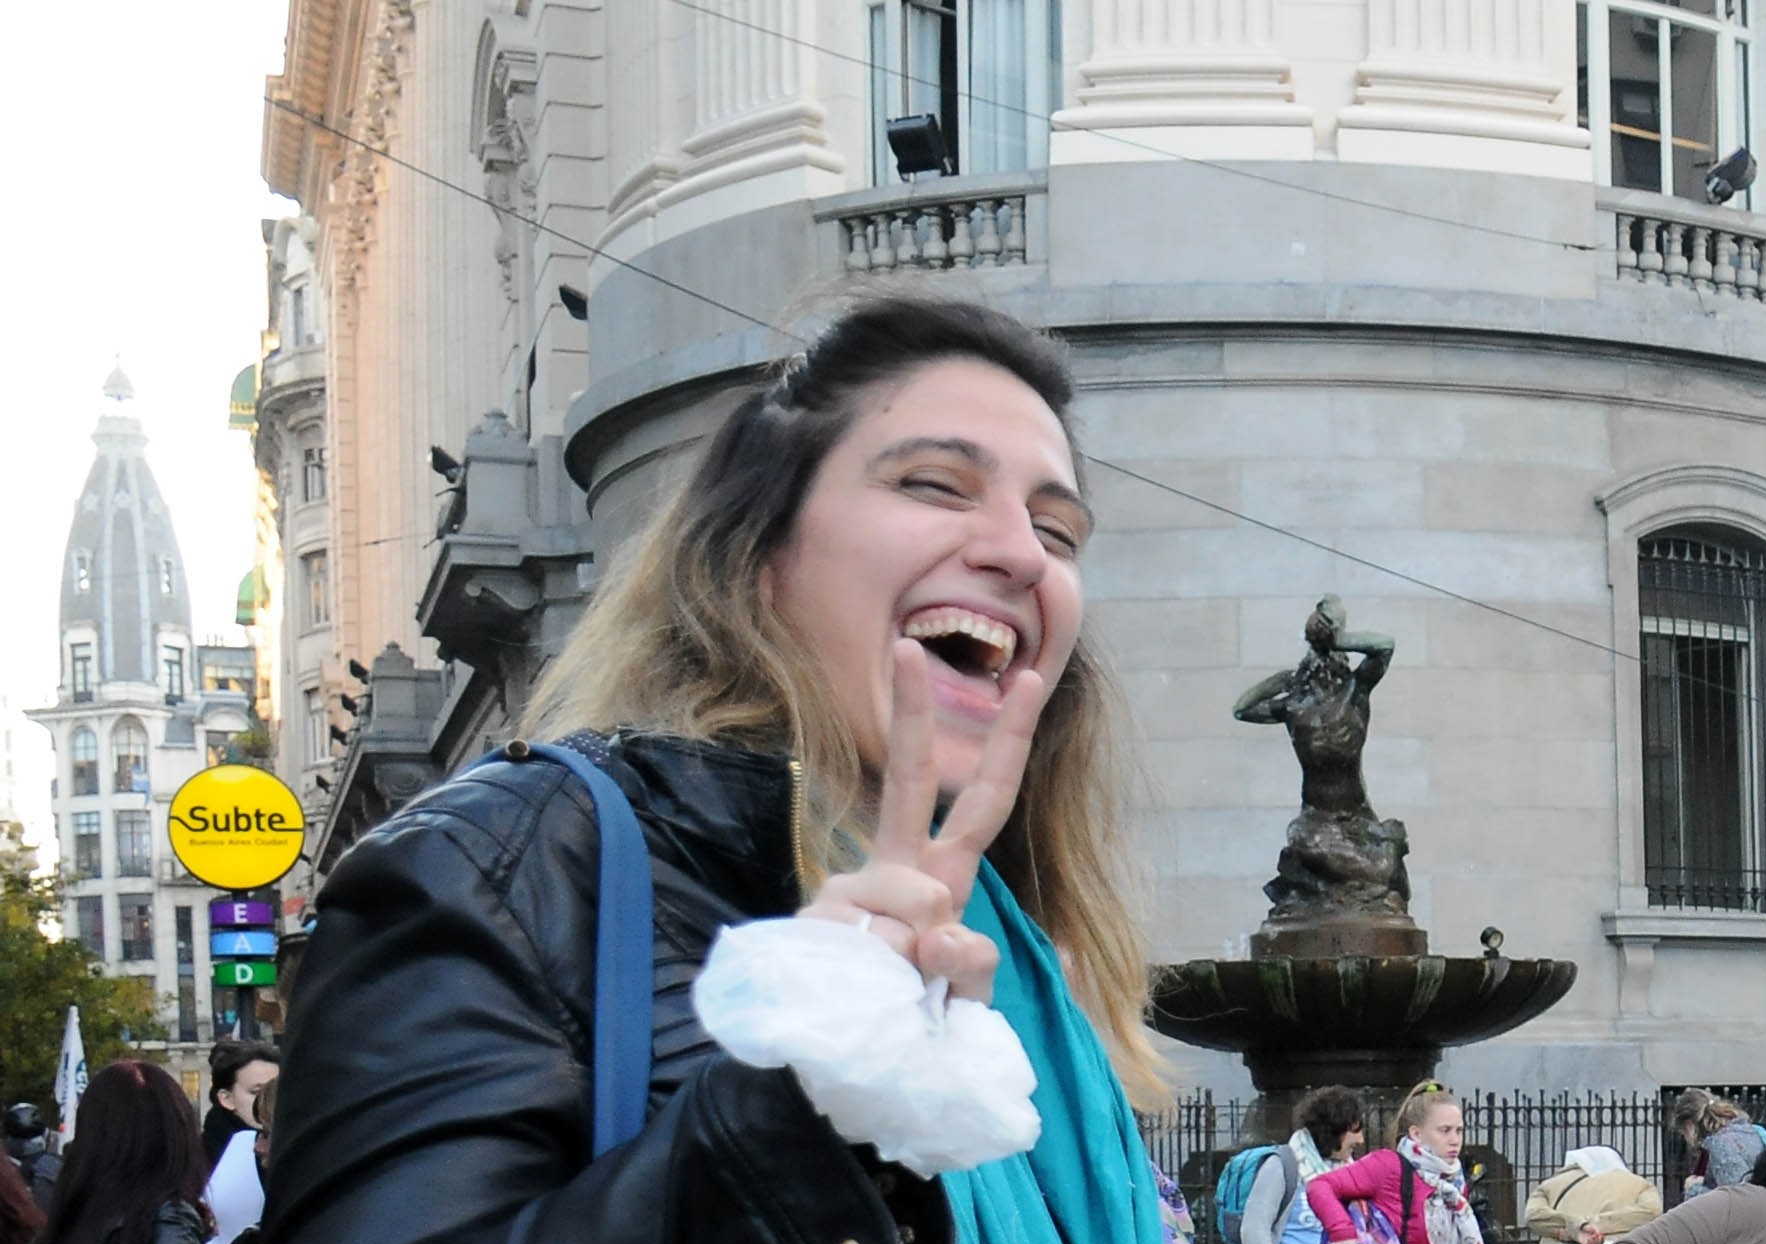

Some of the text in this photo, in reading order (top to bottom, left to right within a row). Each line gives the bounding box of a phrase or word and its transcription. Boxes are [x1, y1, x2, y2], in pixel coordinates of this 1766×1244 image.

[188, 805, 287, 832] Subte
[233, 903, 248, 924] E
[234, 932, 253, 953] A
[235, 963, 253, 984] D
